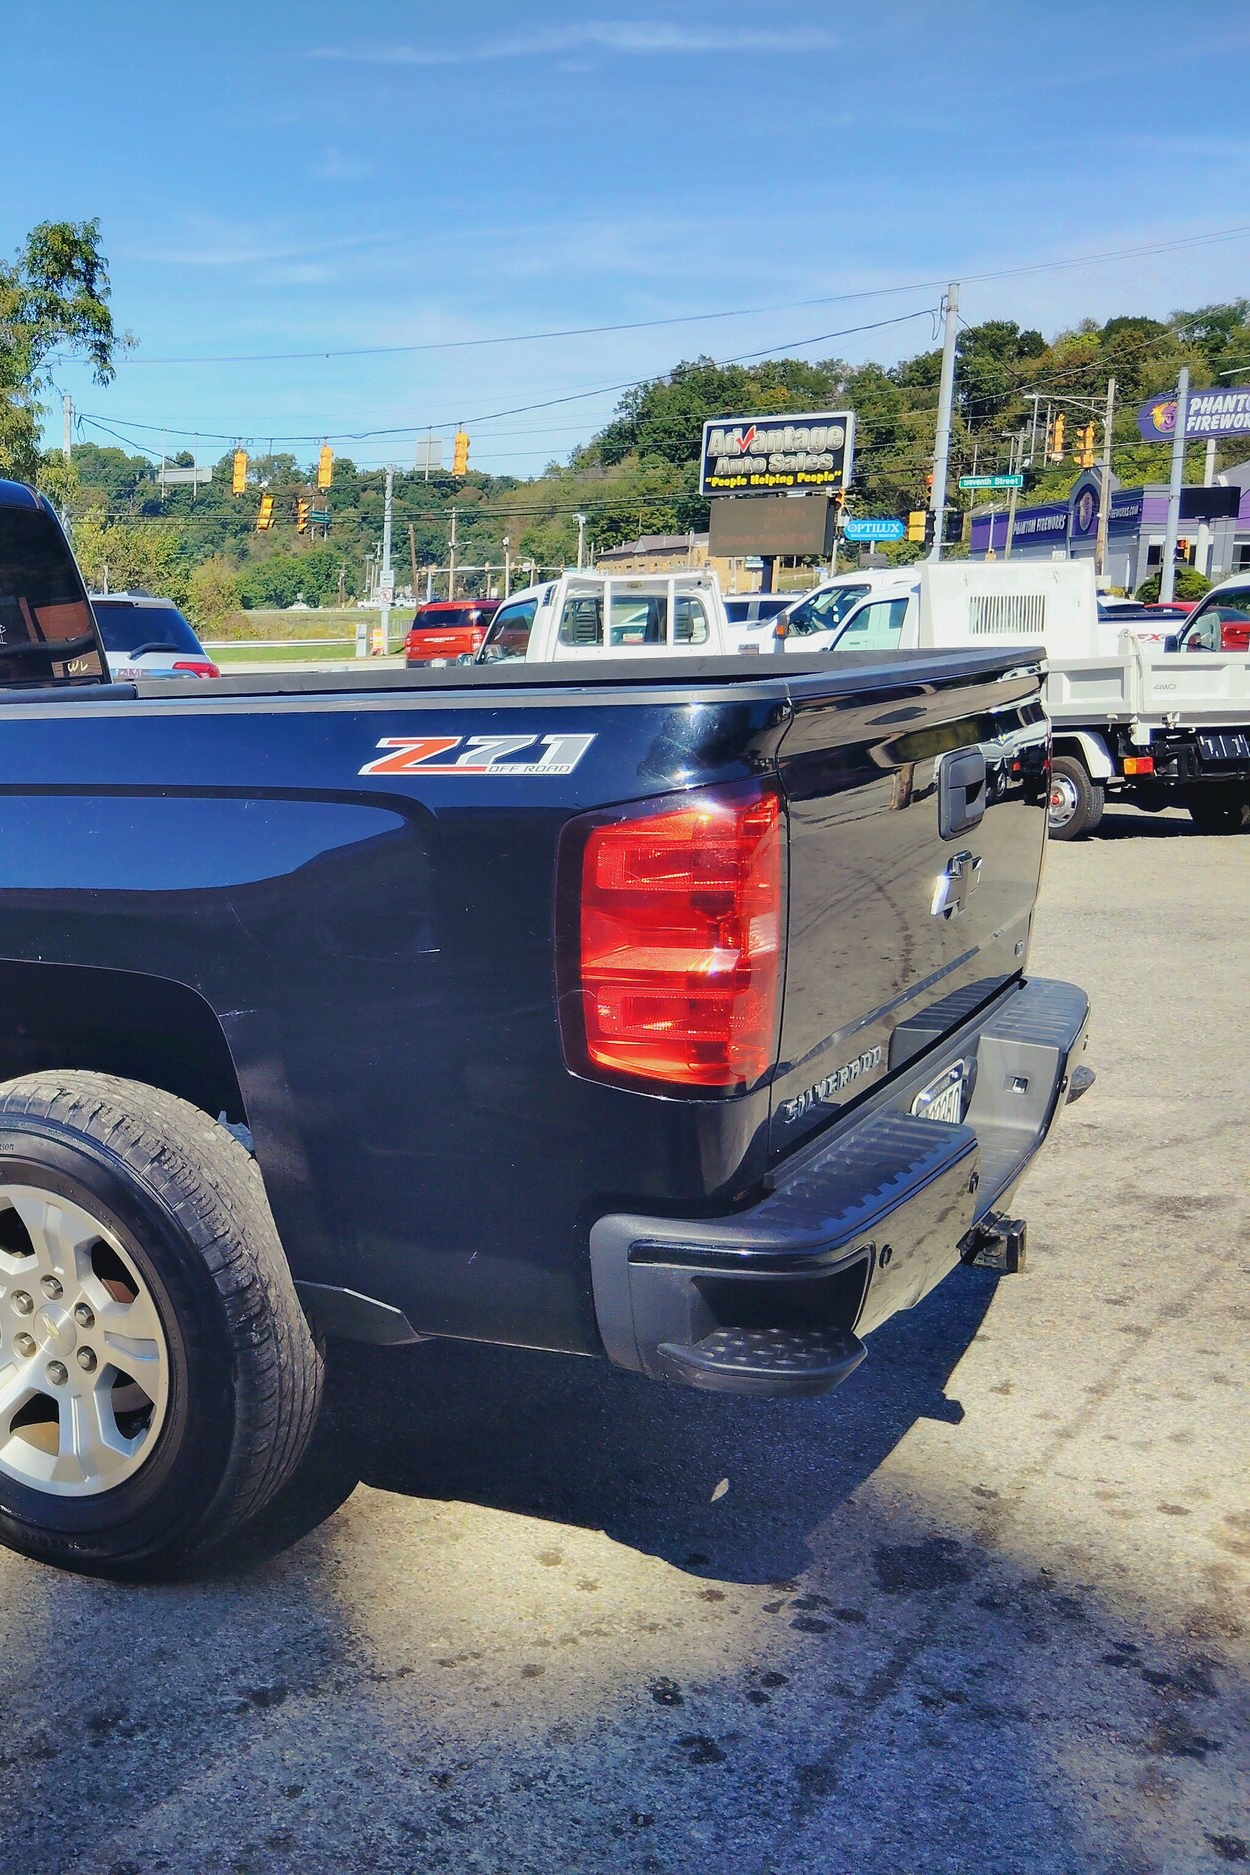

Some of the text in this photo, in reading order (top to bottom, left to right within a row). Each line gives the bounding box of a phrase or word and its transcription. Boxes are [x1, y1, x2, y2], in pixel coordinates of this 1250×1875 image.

[714, 452, 834, 475] Auto Sales
[750, 473, 794, 486] Helping
[963, 477, 1019, 486] Seventh Street
[847, 523, 900, 533] OPTILUX
[1013, 515, 1067, 535] PHANTOM FIREWORKS
[357, 733, 598, 776] Z71
[488, 765, 571, 773] OFF ROAD
[783, 1045, 882, 1124] SILVERADO
